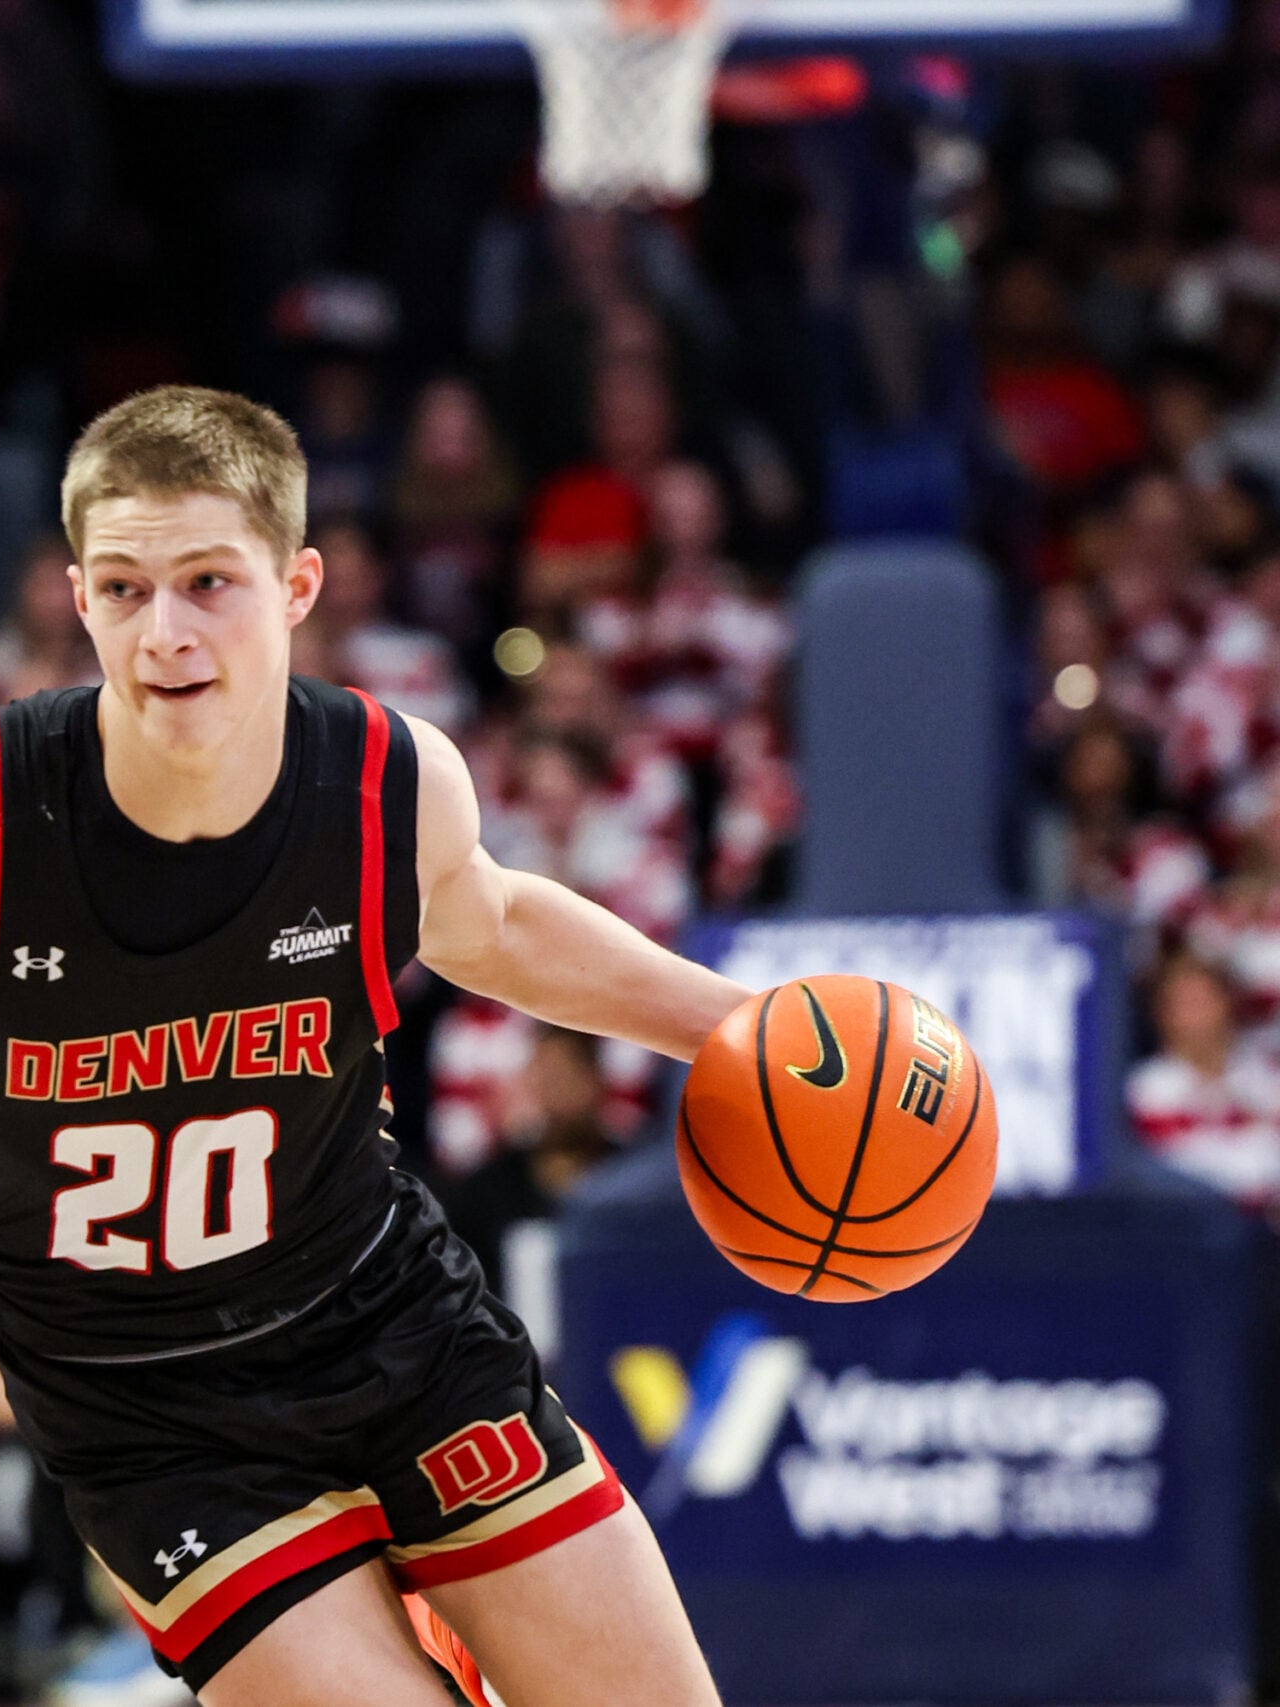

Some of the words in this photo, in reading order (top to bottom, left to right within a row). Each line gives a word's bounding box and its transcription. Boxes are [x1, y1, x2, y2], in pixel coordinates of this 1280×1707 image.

[268, 923, 352, 960] SUMMIT
[288, 947, 336, 964] LEAGUE
[5, 997, 333, 1102] DENVER
[896, 992, 954, 1126] ELITE
[47, 1106, 278, 1276] 20
[416, 1411, 548, 1516] DU
